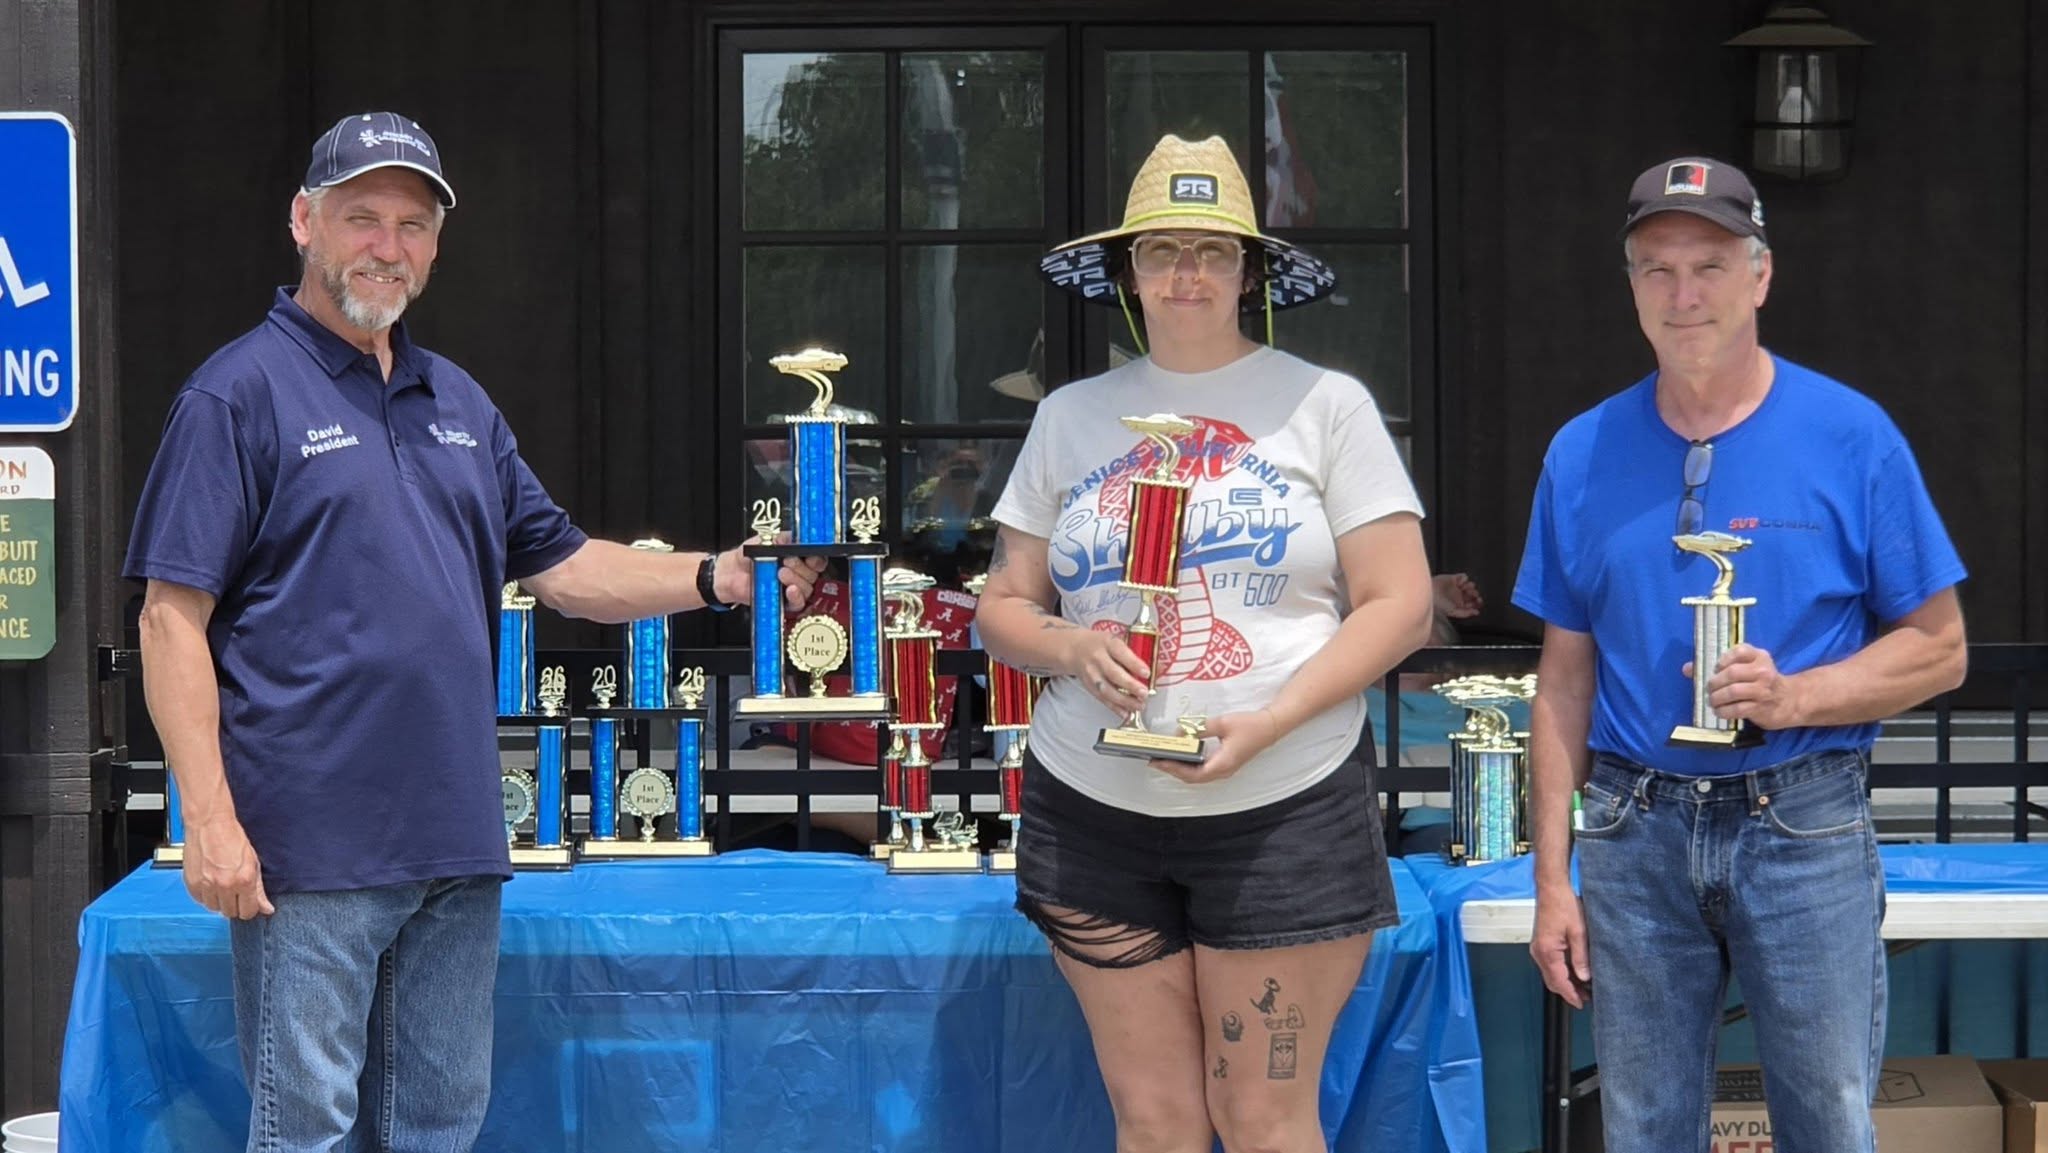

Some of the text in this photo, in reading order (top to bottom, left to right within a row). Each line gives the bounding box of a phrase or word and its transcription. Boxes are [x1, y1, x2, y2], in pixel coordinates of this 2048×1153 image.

[0, 349, 60, 397] NG
[307, 424, 344, 442] David
[301, 435, 360, 458] President
[753, 497, 781, 525] 20
[851, 496, 881, 525] 26
[1048, 499, 1303, 592] Shlby
[811, 634, 825, 643] 1st
[804, 646, 831, 657] Place
[592, 665, 617, 690] 20
[680, 666, 706, 692] 26
[637, 795, 659, 803] Place
